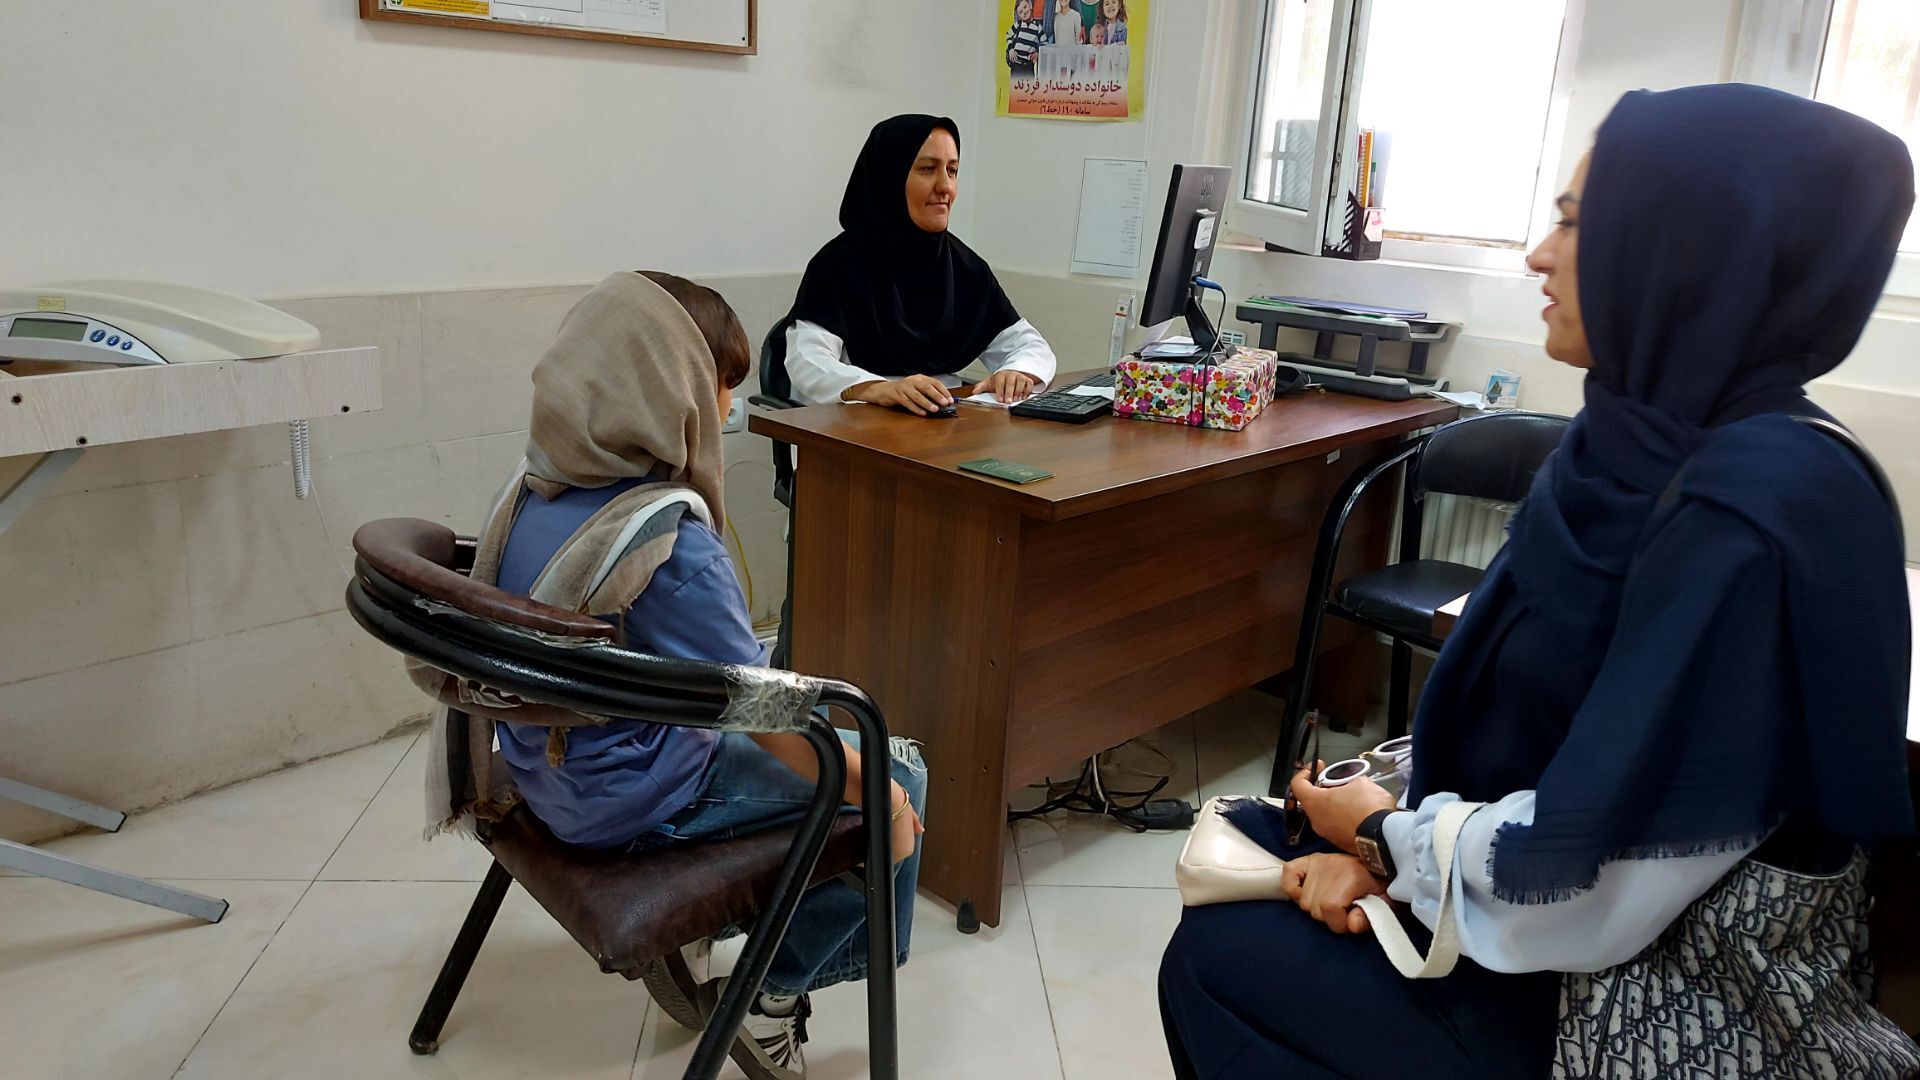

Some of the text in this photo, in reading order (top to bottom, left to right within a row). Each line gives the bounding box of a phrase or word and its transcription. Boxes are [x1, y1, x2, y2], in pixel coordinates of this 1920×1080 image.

[1014, 78, 1122, 97] خانواده دوستدار فرزند
